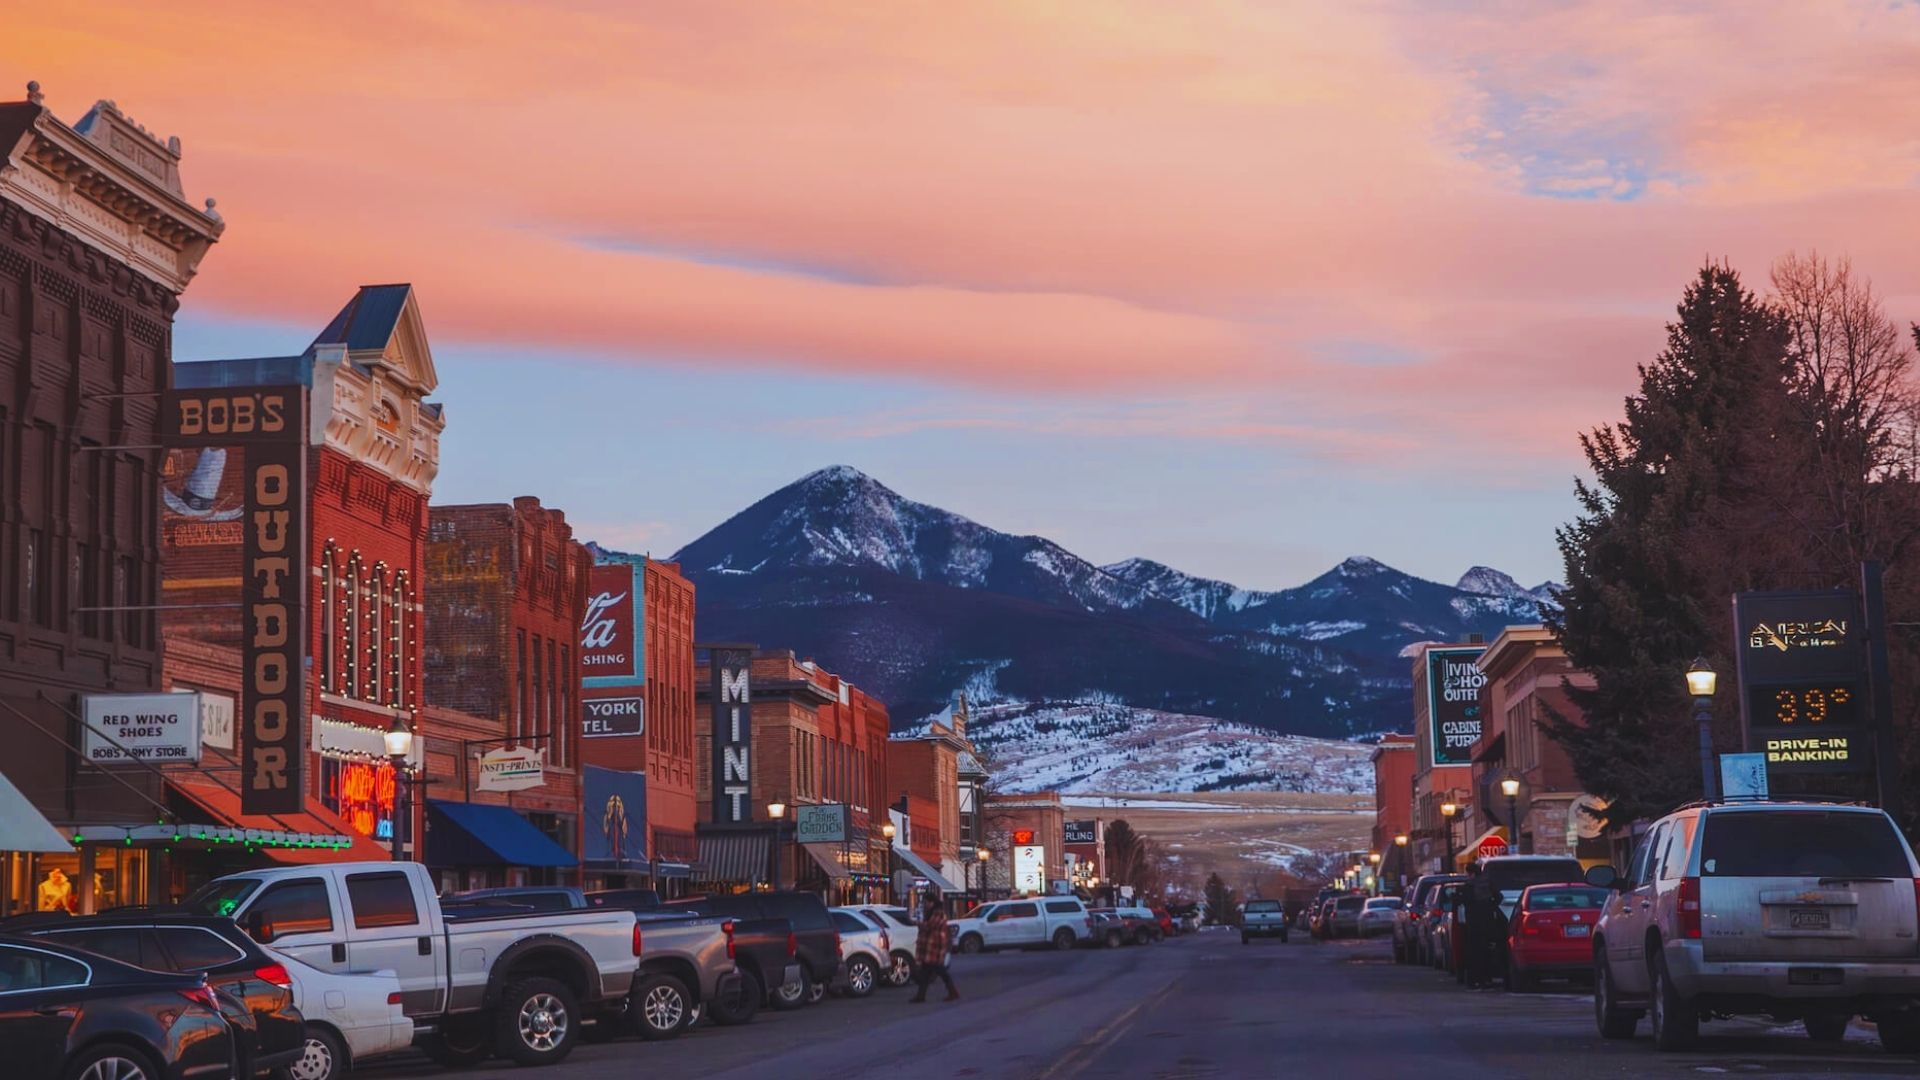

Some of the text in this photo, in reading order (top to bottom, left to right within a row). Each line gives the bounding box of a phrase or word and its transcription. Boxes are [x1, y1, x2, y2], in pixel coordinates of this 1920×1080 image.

[179, 393, 284, 434] BOB'S
[253, 463, 289, 790] OUTDOOR
[583, 654, 625, 665] SHING
[589, 702, 637, 716] YORK
[103, 714, 178, 726] RED WING
[119, 727, 163, 737] SHOES
[721, 668, 748, 821] MINT
[1767, 739, 1848, 750] DRIVE-IN
[93, 748, 120, 758] BOB'S
[155, 747, 187, 757] STORE
[1768, 750, 1848, 762] BANKING
[1480, 845, 1505, 858] STOP
